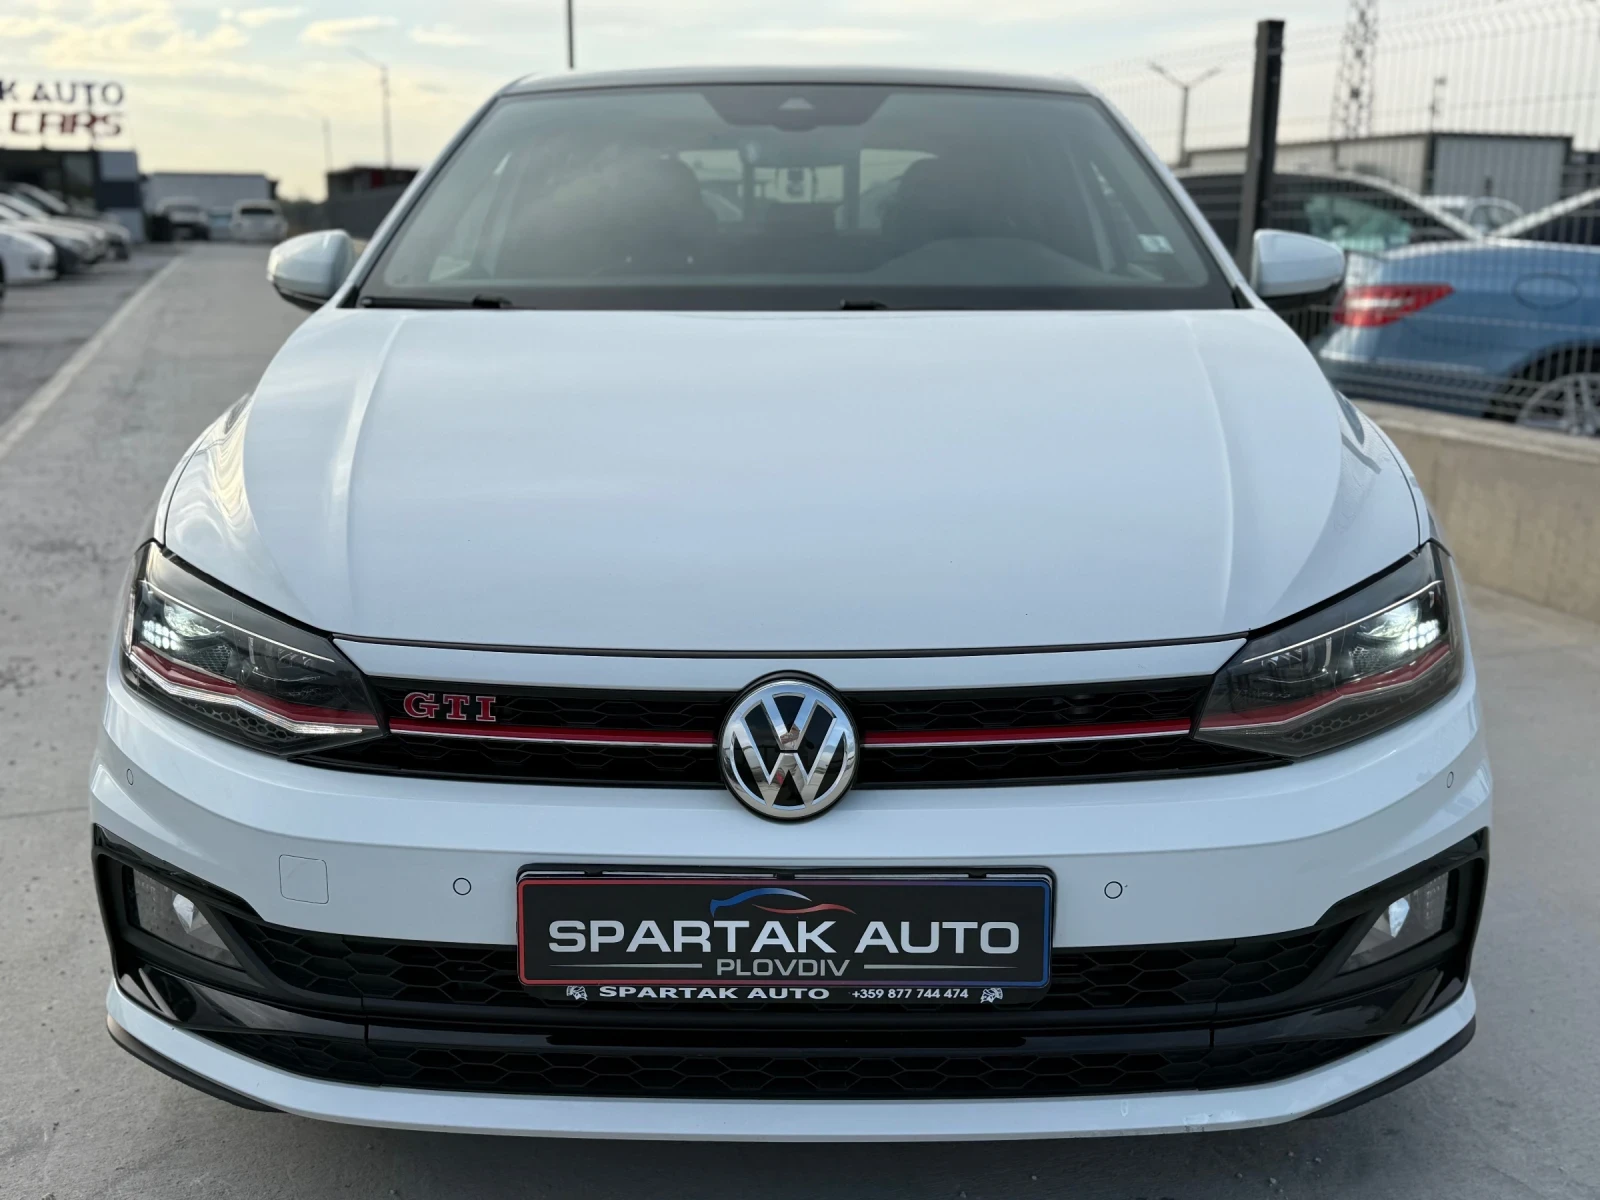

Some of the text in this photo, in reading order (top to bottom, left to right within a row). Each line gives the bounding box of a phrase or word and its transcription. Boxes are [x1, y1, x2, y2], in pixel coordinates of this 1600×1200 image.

[32, 81, 124, 105] AUTO
[10, 110, 123, 136] CARS
[403, 692, 497, 722] GTI
[548, 920, 1019, 954] SPARTAK AUTO
[716, 958, 850, 976] PLOVDIV
[599, 986, 969, 1000] SPARTAK AUTO +359 877 744 474
